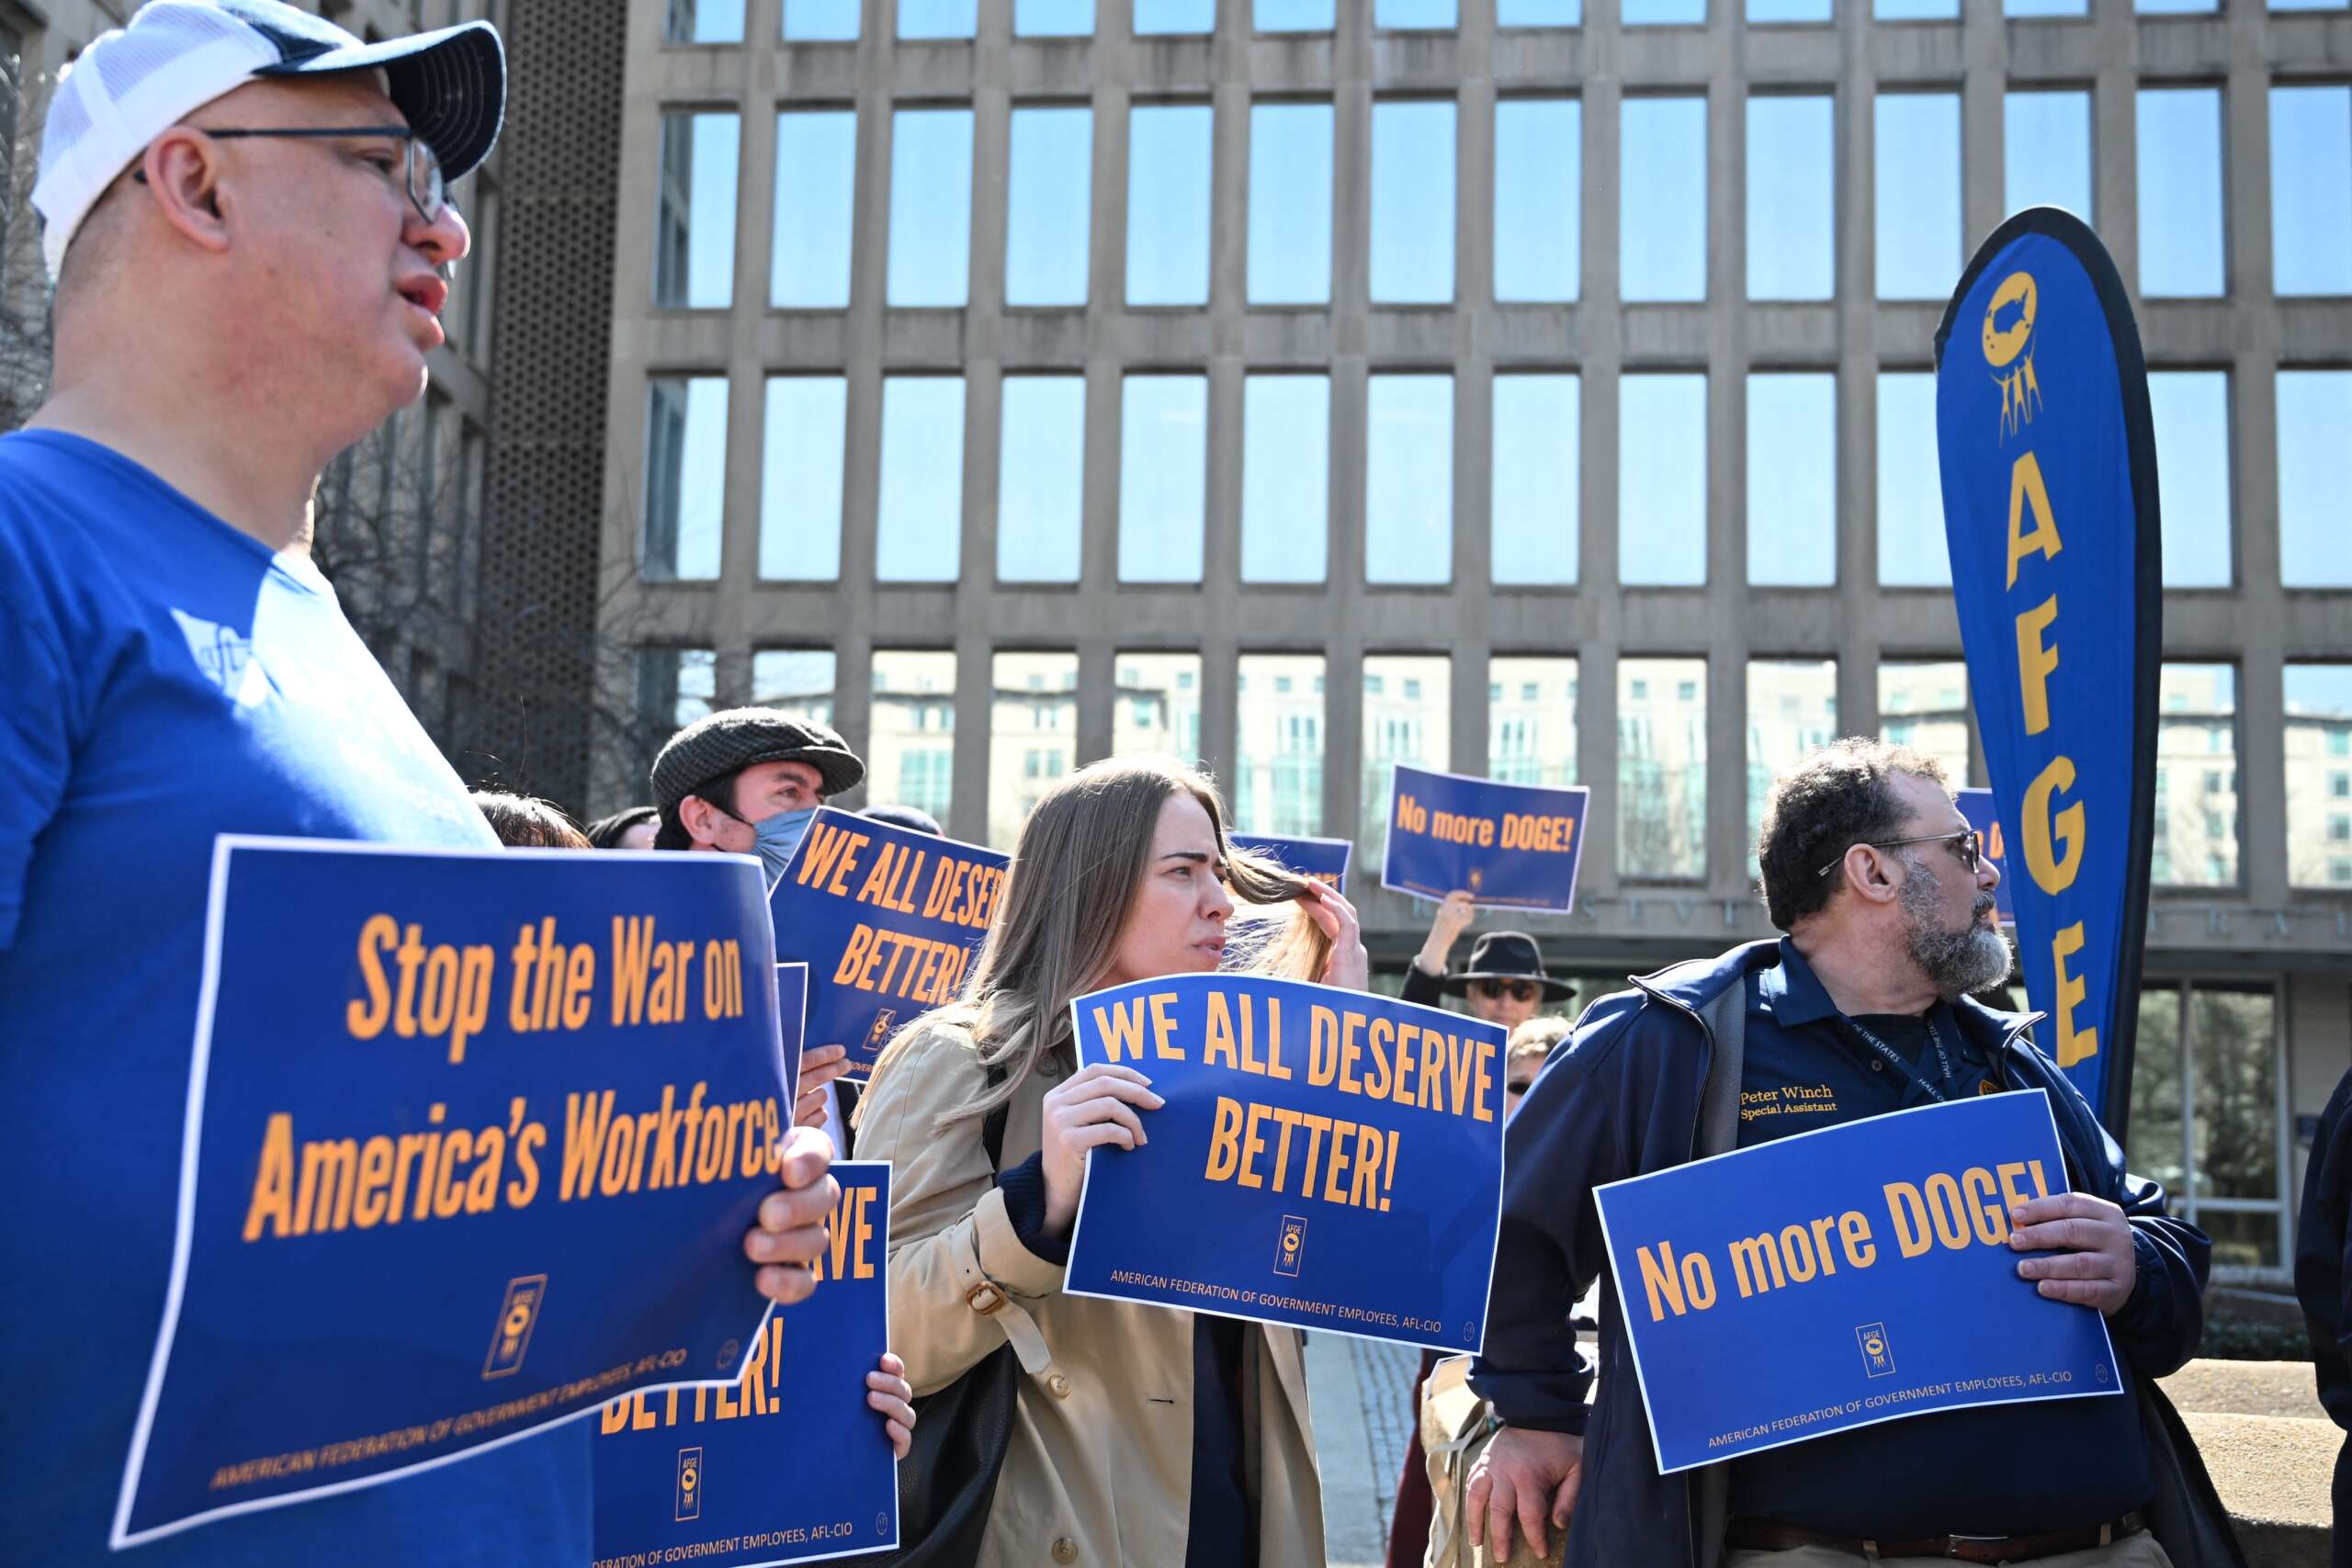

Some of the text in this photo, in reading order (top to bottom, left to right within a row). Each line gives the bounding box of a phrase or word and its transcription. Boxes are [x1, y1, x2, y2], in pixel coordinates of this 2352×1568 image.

[2007, 451, 2098, 1067] AFGE
[1396, 794, 1575, 852] No more DOGE!
[797, 822, 870, 897] WE
[856, 841, 926, 914] ALL
[347, 915, 743, 1063] Stop the War on
[1092, 991, 1496, 1122] WE ALL DESERVE
[1861, 1031, 1877, 1044] THE
[1874, 1041, 1901, 1063] STATES
[1740, 1084, 1834, 1105] Peter Winch
[1740, 1101, 1838, 1121] Special Assistant
[1917, 1077, 1938, 1096] HALL
[243, 1082, 782, 1241] America's Workforce
[1204, 1096, 1400, 1213] BETTER!
[1285, 1224, 1301, 1235] AFGE
[1636, 1240, 1717, 1322] No
[1728, 1210, 1876, 1298] more
[1111, 1269, 1168, 1289] AMERICAN
[1170, 1279, 1239, 1301] FEDERATION
[1241, 1291, 1258, 1303] OF
[1259, 1293, 1336, 1316] GOVERNMENT
[1338, 1305, 1401, 1328] EMPLOYEES,
[1402, 1315, 1442, 1334] AFL-CIO
[1863, 1329, 1882, 1341] AFGE
[209, 1449, 319, 1490] AMERICAN
[319, 1425, 428, 1467] FEDERATION
[428, 1416, 455, 1443] OF
[454, 1387, 560, 1437] GOVERNMENT
[1708, 1423, 1770, 1449] AMERICAN
[1771, 1404, 1843, 1433] FEDERATION
[1845, 1399, 1862, 1414] OF
[1864, 1382, 1952, 1409] GOVERNMENT
[1954, 1374, 2027, 1393] EMPLOYEES,
[2028, 1371, 2072, 1385] AFL-CIO
[683, 1457, 698, 1470] AFGE
[648, 1550, 662, 1566] OF
[664, 1537, 741, 1562] GOVERNMENT
[743, 1528, 809, 1551] EMPLOYEES,
[811, 1521, 853, 1540] AFL-CIO
